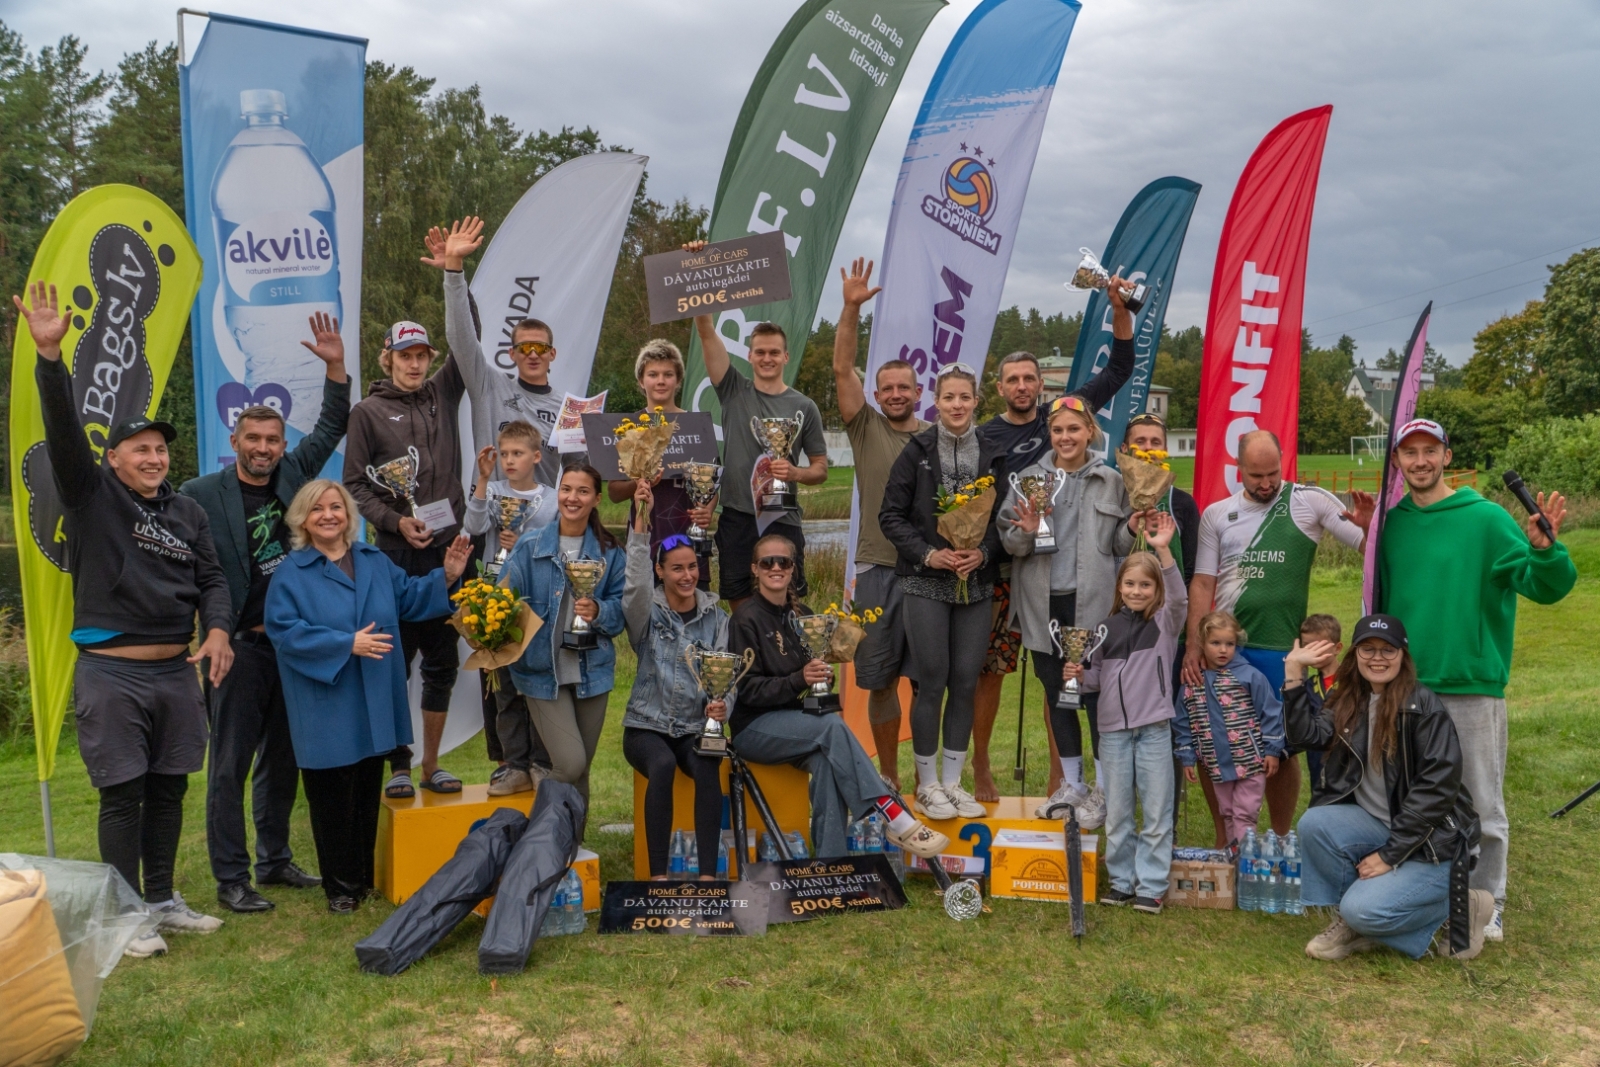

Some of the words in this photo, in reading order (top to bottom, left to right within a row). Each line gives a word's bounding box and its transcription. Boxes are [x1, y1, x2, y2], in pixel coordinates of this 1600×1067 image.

[825, 9, 896, 67] aizsardzības
[871, 13, 904, 49] Darba
[849, 47, 889, 87] līdzekļi
[946, 199, 982, 226] SPORTS
[924, 198, 999, 251] STOPIŅIEM
[229, 228, 331, 263] akvilė
[681, 256, 707, 269] HOME
[709, 254, 721, 263] OF
[723, 248, 749, 261] CARS
[246, 266, 272, 275] natural
[273, 265, 300, 274] mineral
[664, 266, 723, 287] DĀVANU
[726, 257, 771, 275] KARTE
[685, 282, 710, 293] auto
[711, 271, 751, 288] iegādei
[270, 286, 301, 297] STILL
[677, 290, 728, 313] 500€
[731, 287, 764, 300] vērtībā
[1275, 503, 1288, 517] 2
[1369, 619, 1388, 629] alo
[785, 867, 812, 876] HOME
[815, 866, 827, 874] OF
[829, 864, 855, 873] CARS
[770, 876, 832, 891] DĀVANU
[835, 873, 881, 884] KARTE
[796, 889, 822, 897] auto
[823, 884, 864, 896] iegādei
[681, 888, 695, 896] OF
[698, 888, 727, 896] CARS
[623, 897, 693, 907] DĀVANU
[697, 899, 749, 908] KARTE
[790, 897, 845, 915] 500€
[847, 896, 882, 907] vērtībā
[677, 907, 722, 917] iegādei
[631, 917, 692, 931] 500€
[696, 921, 735, 929] vērtībā
